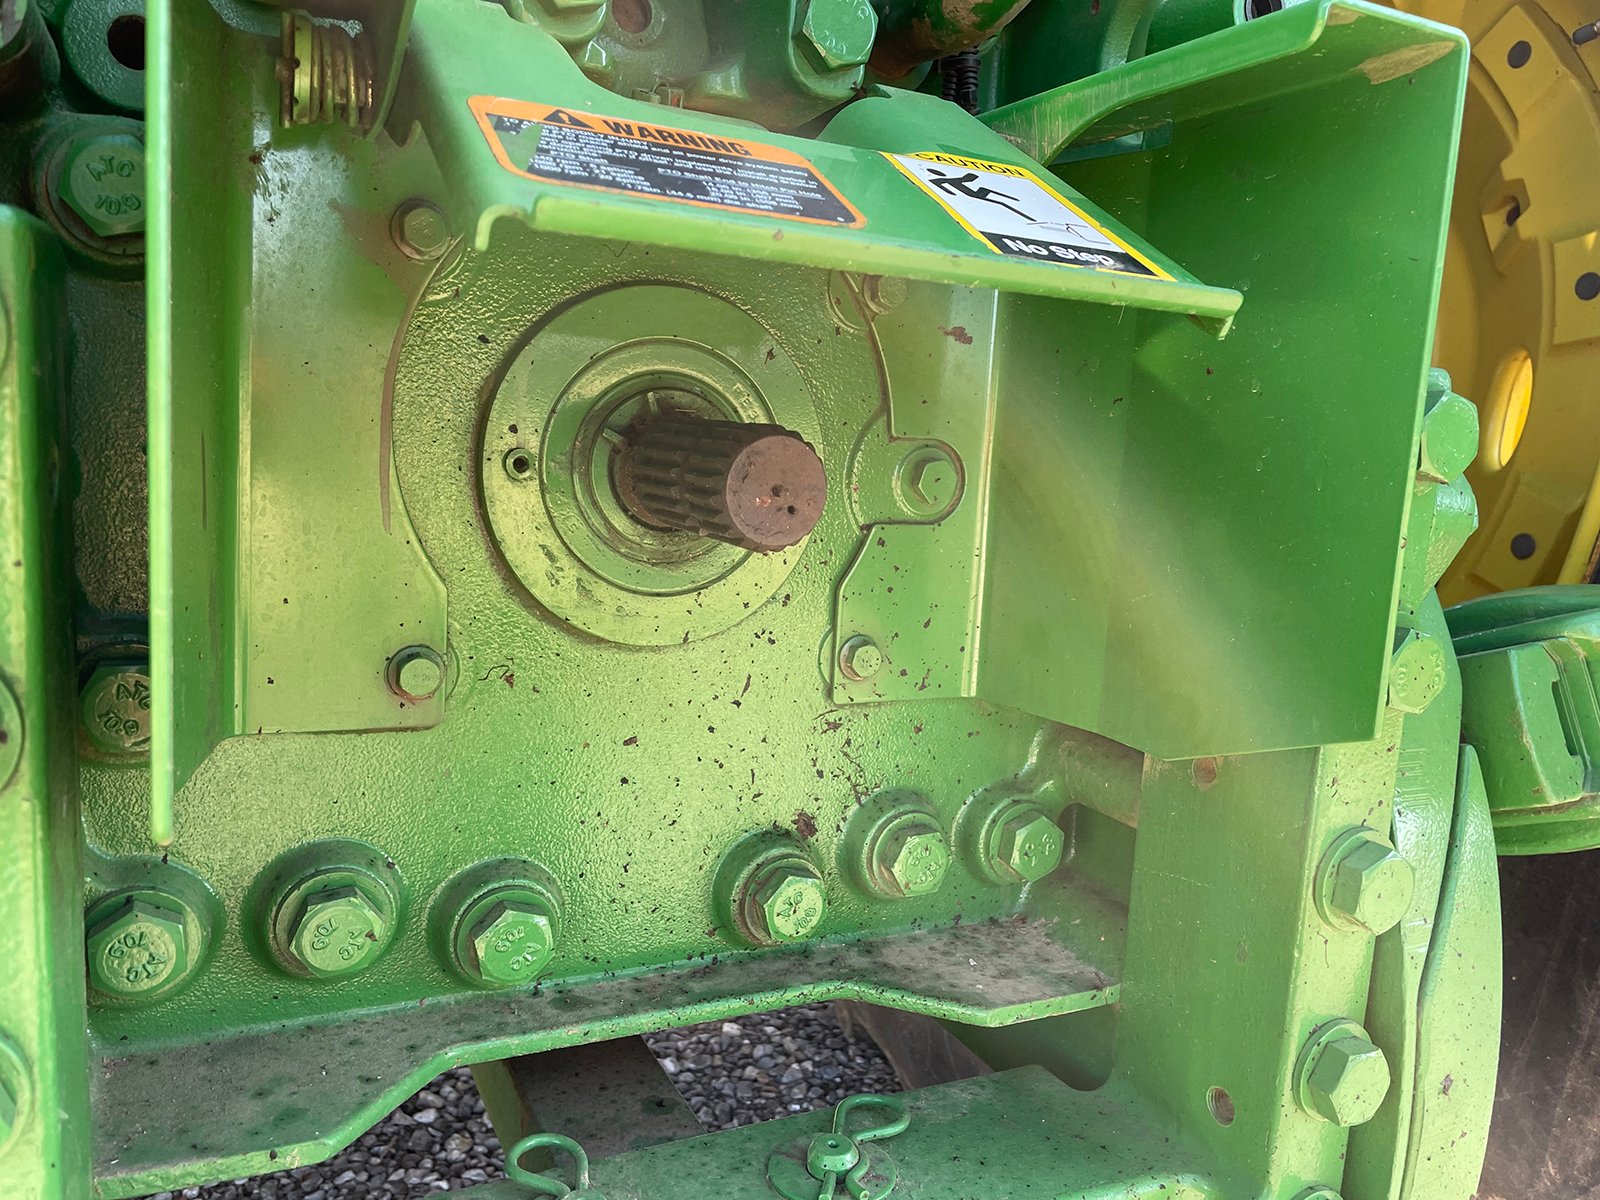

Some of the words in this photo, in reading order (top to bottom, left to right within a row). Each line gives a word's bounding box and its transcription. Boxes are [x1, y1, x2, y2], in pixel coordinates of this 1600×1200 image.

[602, 119, 753, 157] WARNING
[915, 152, 1027, 177] CAUTION
[1001, 237, 1044, 257] No
[1045, 244, 1115, 267] Step
